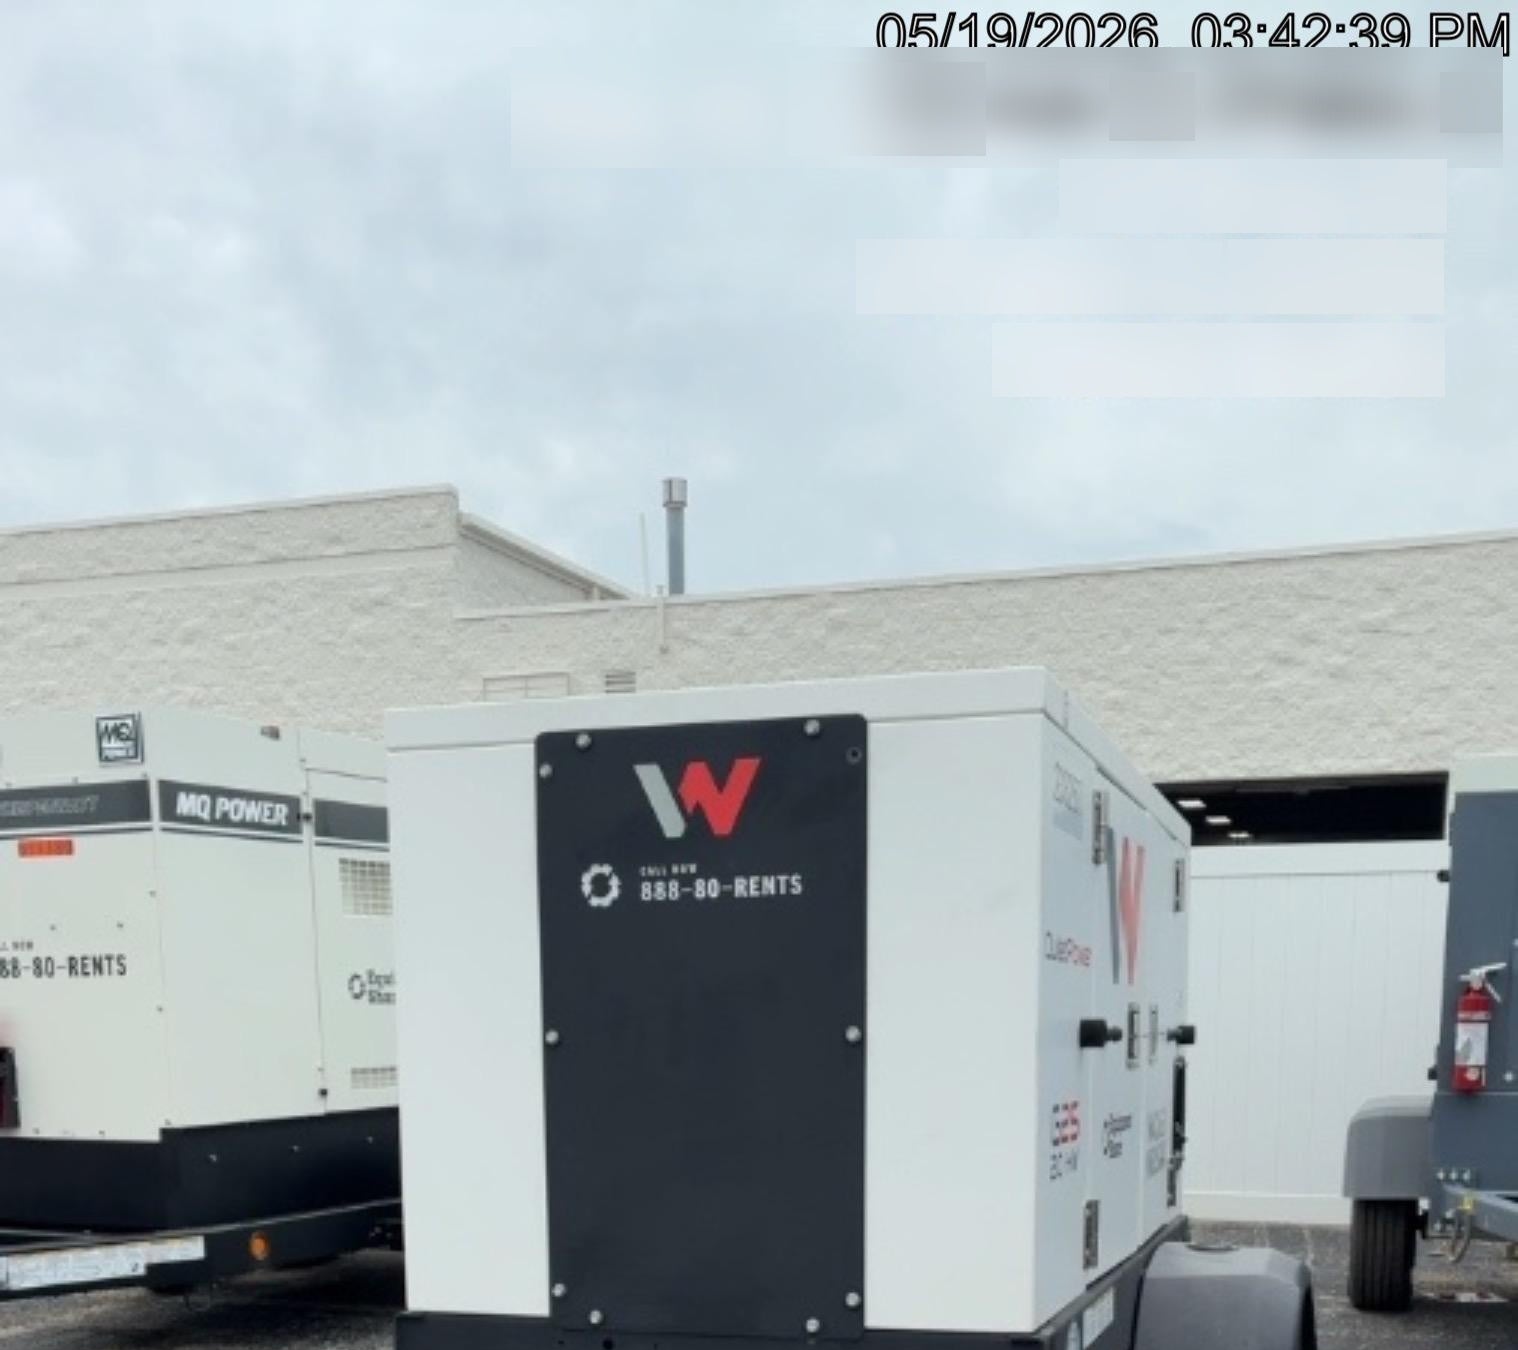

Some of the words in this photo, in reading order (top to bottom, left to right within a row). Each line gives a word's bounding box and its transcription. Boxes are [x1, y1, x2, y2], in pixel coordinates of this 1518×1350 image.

[176, 791, 210, 821] MQ
[215, 798, 289, 826] POWER
[640, 873, 802, 901] 888-80-RENTS
